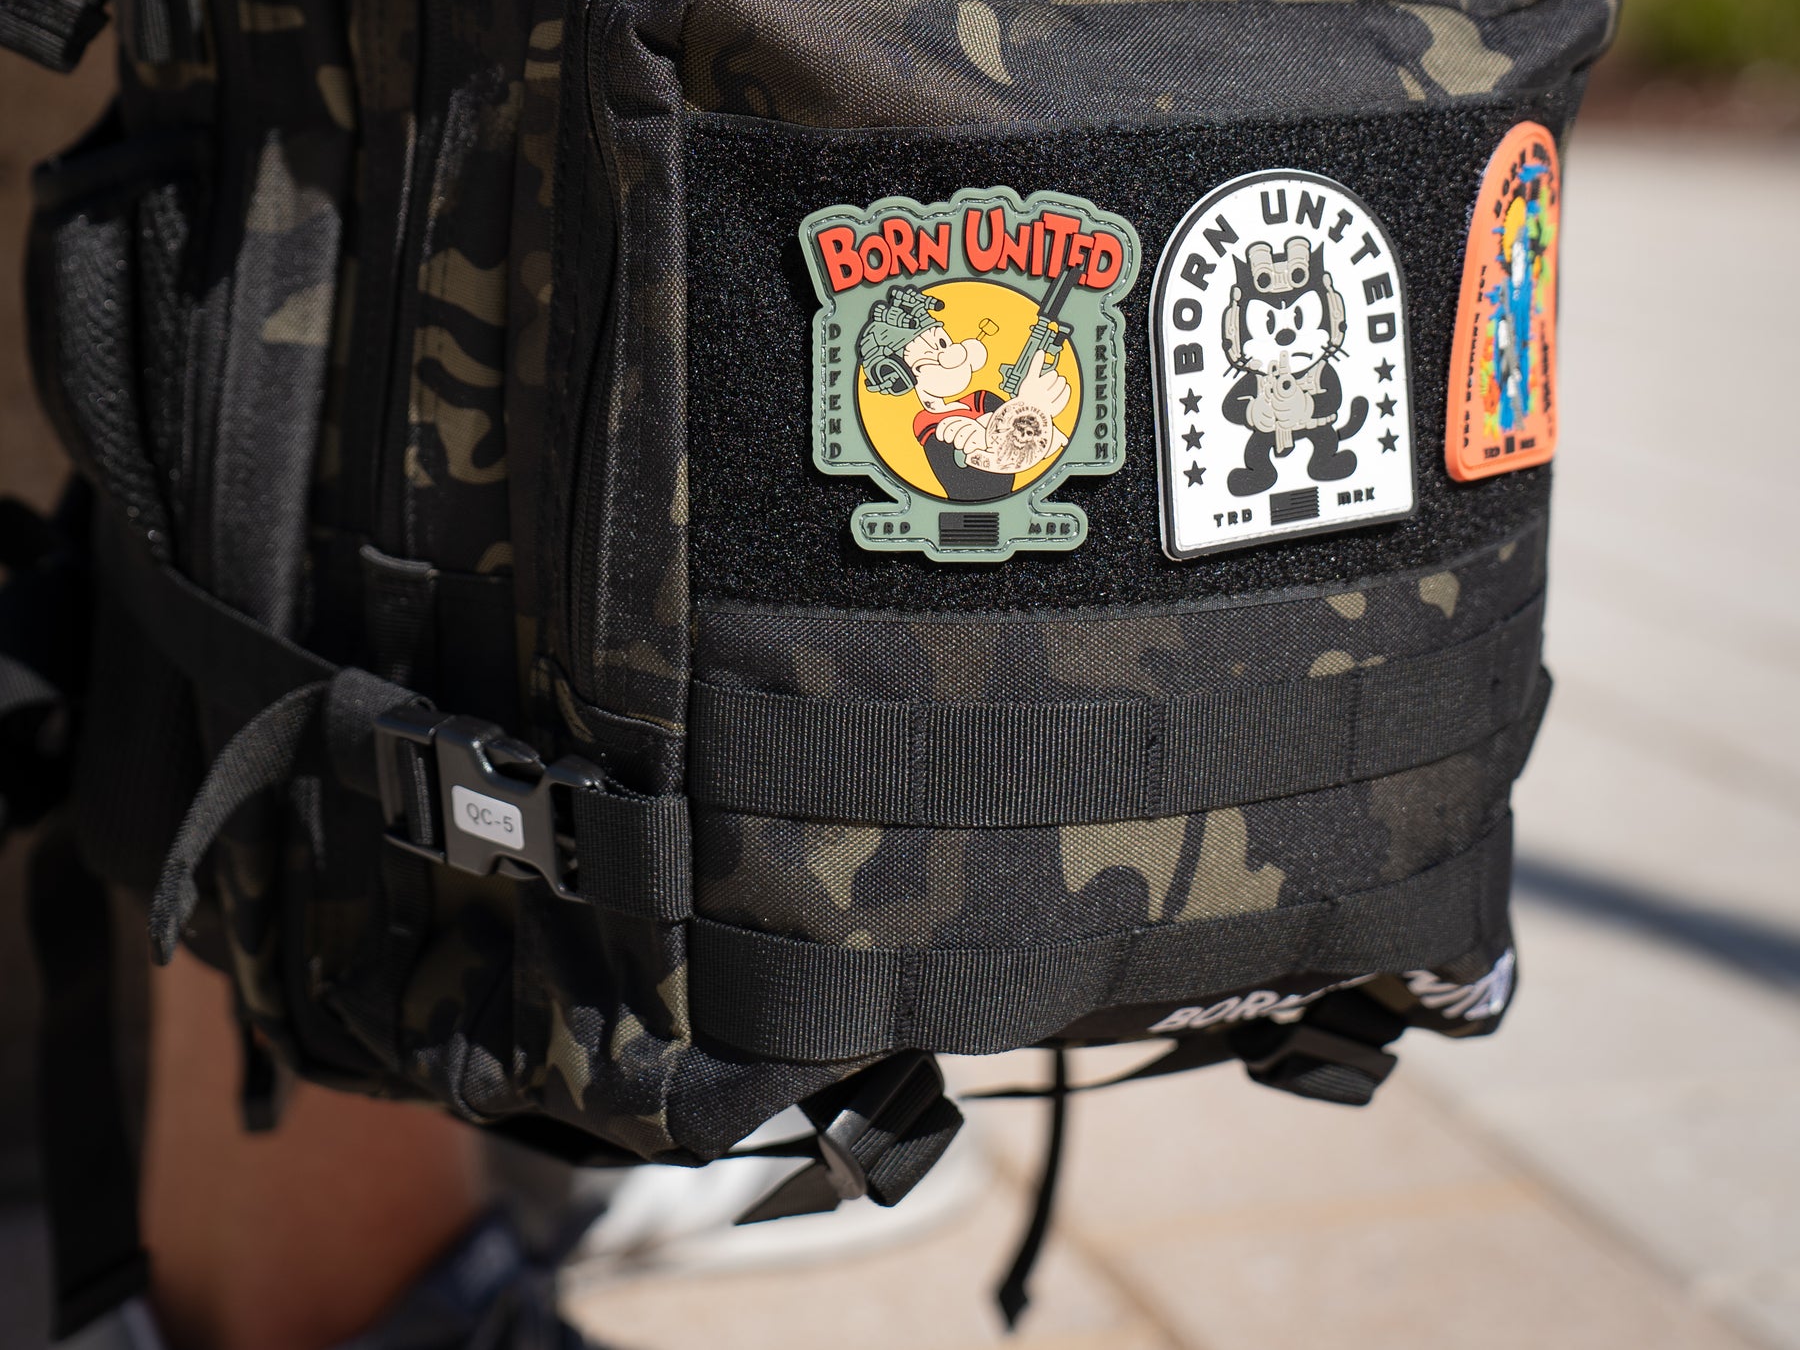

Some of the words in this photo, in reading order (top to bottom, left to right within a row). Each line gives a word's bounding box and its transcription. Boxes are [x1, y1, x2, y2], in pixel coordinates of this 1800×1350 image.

[817, 217, 952, 292] BORN
[964, 208, 1122, 290] UNITED
[1174, 214, 1239, 375] BORN
[1261, 188, 1397, 344] UNITED
[827, 323, 842, 459] DEFEND
[1094, 324, 1109, 459] FREEDOM
[1337, 486, 1376, 506] MRK
[866, 520, 912, 535] TRD
[1028, 520, 1071, 536] MRK
[1213, 508, 1253, 528] TRD
[466, 802, 515, 833] QC-5
